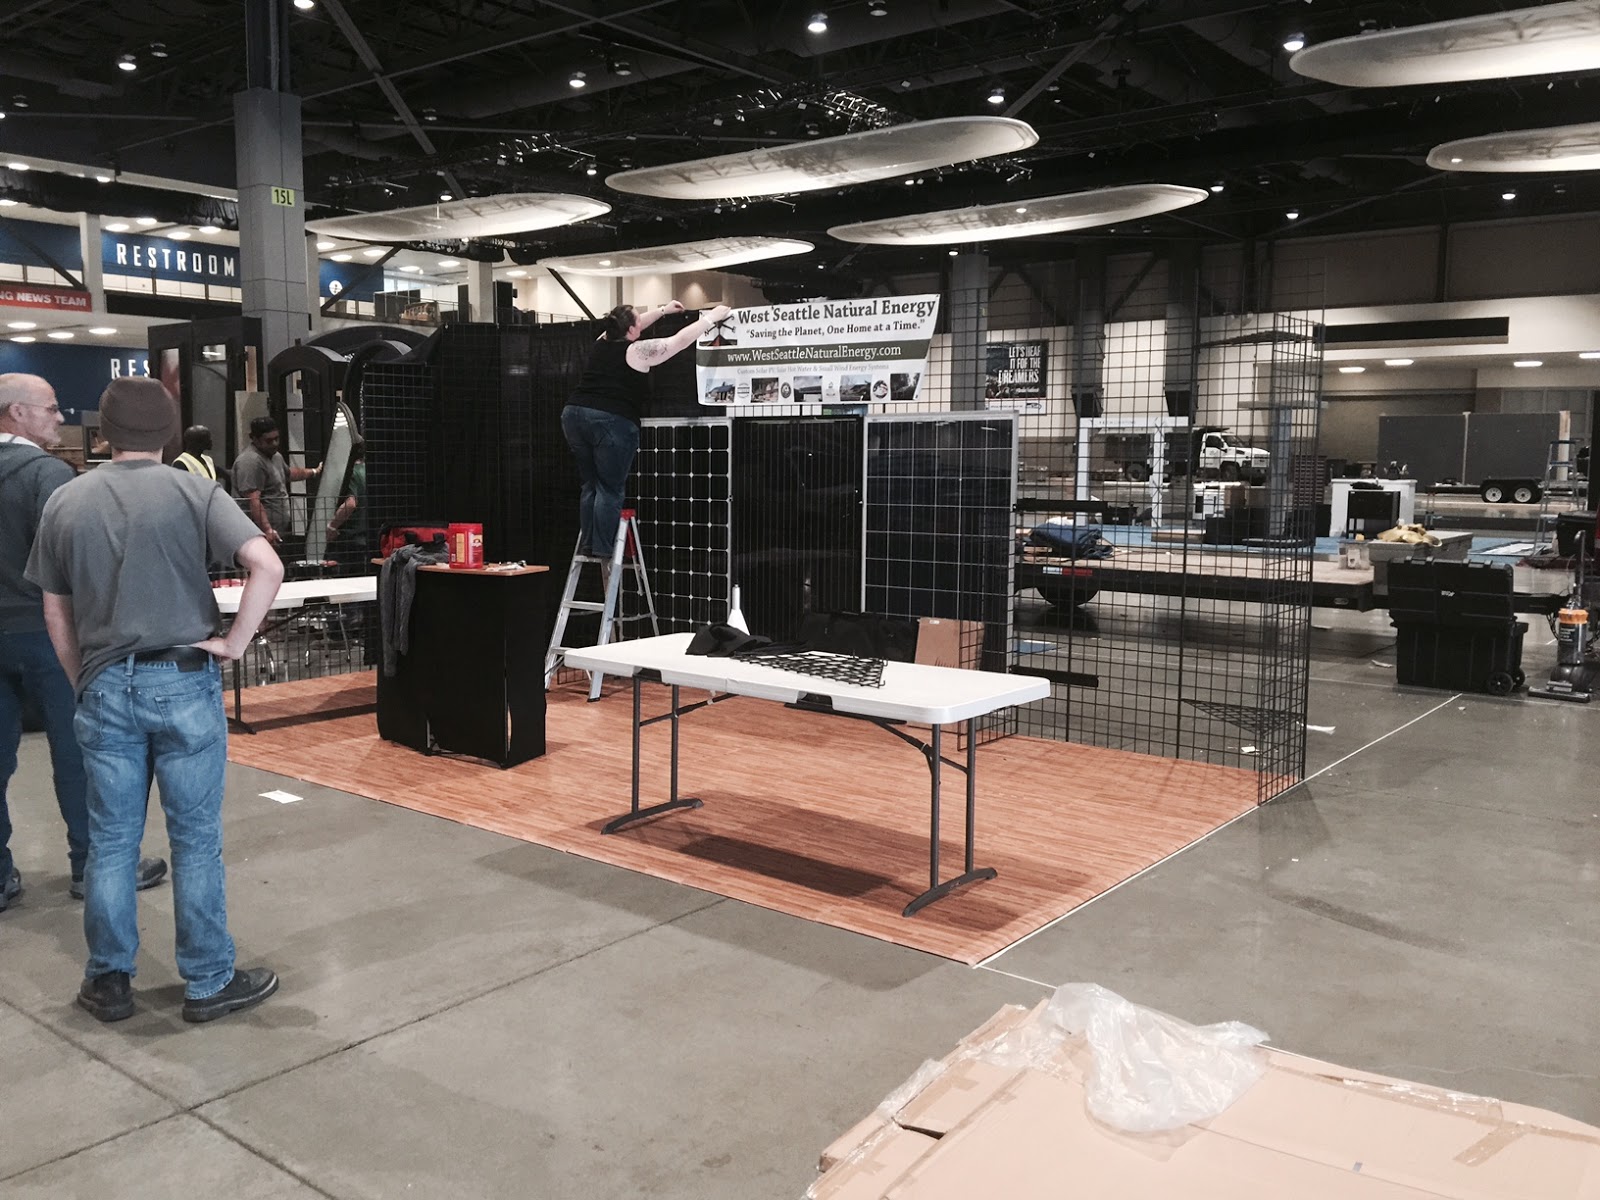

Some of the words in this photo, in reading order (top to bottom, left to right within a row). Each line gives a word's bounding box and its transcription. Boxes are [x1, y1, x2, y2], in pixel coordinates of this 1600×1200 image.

[274, 189, 292, 205] 15L
[116, 243, 235, 277] RESTROOM
[16, 292, 52, 304] NEWS
[54, 295, 87, 307] TEAM
[738, 310, 770, 324] West
[773, 305, 820, 322] Seattle
[824, 300, 877, 319] Natural
[882, 299, 936, 318] Energy
[778, 327, 792, 337] the
[795, 326, 825, 336] Planet,
[827, 325, 845, 334] One
[847, 324, 872, 333] Home
[873, 323, 884, 332] at
[727, 345, 901, 362] www.WestSeattleNaturalEnergy.com
[849, 364, 867, 372] Energy
[868, 363, 889, 371] Systems
[1029, 357, 1041, 368] THE
[998, 369, 1039, 384] DREAMERS
